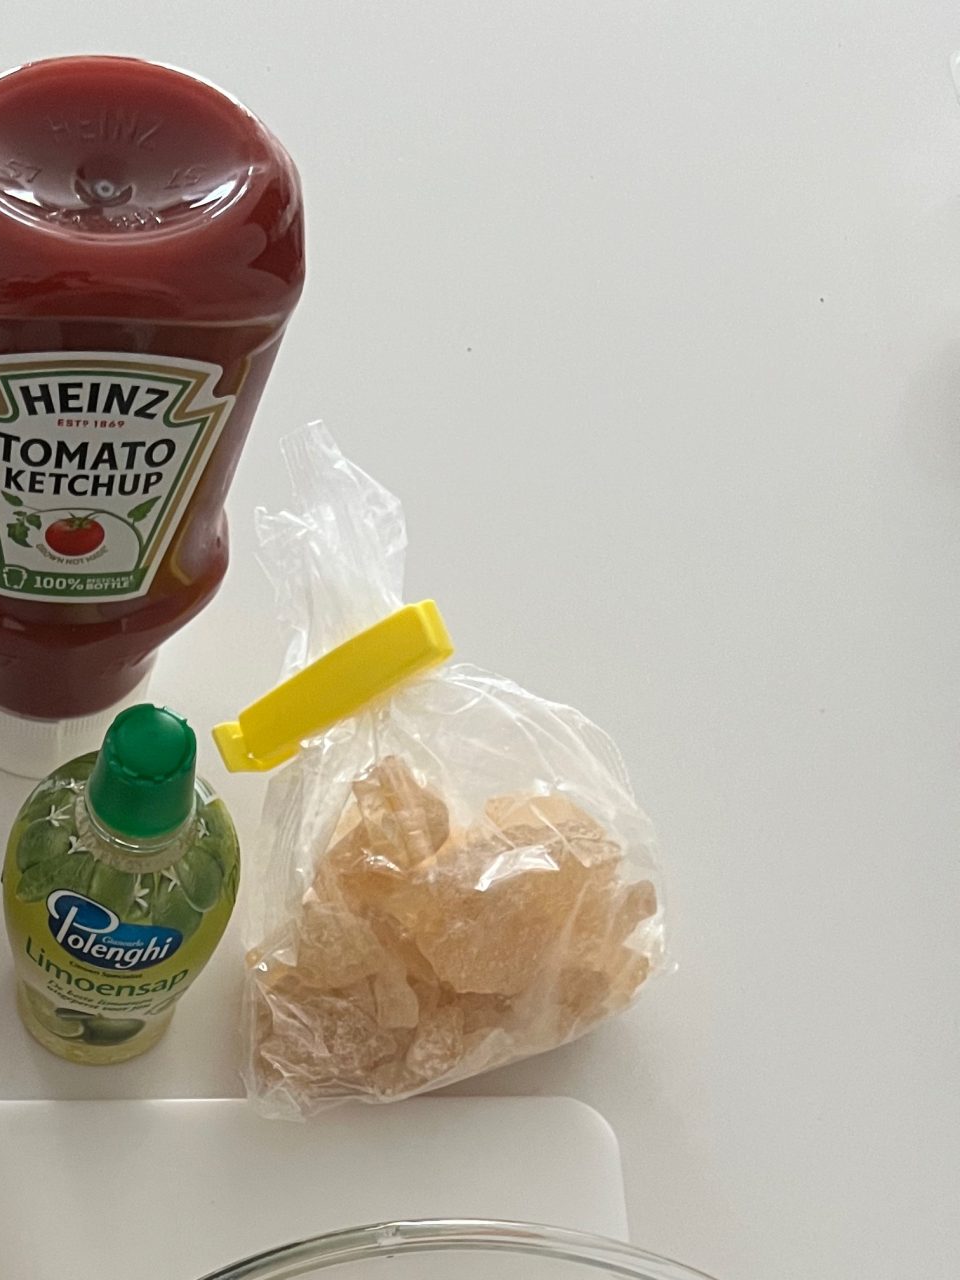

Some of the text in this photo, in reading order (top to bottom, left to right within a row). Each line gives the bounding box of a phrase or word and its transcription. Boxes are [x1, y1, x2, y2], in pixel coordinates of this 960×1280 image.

[18, 382, 170, 420] HEINZ
[94, 420, 126, 429] 1869
[4, 467, 164, 497] KETCHUP
[33, 575, 84, 591] 100%
[85, 581, 131, 591] BOTTLE
[46, 889, 174, 970] Polenghi
[25, 935, 190, 997] Limoensap
